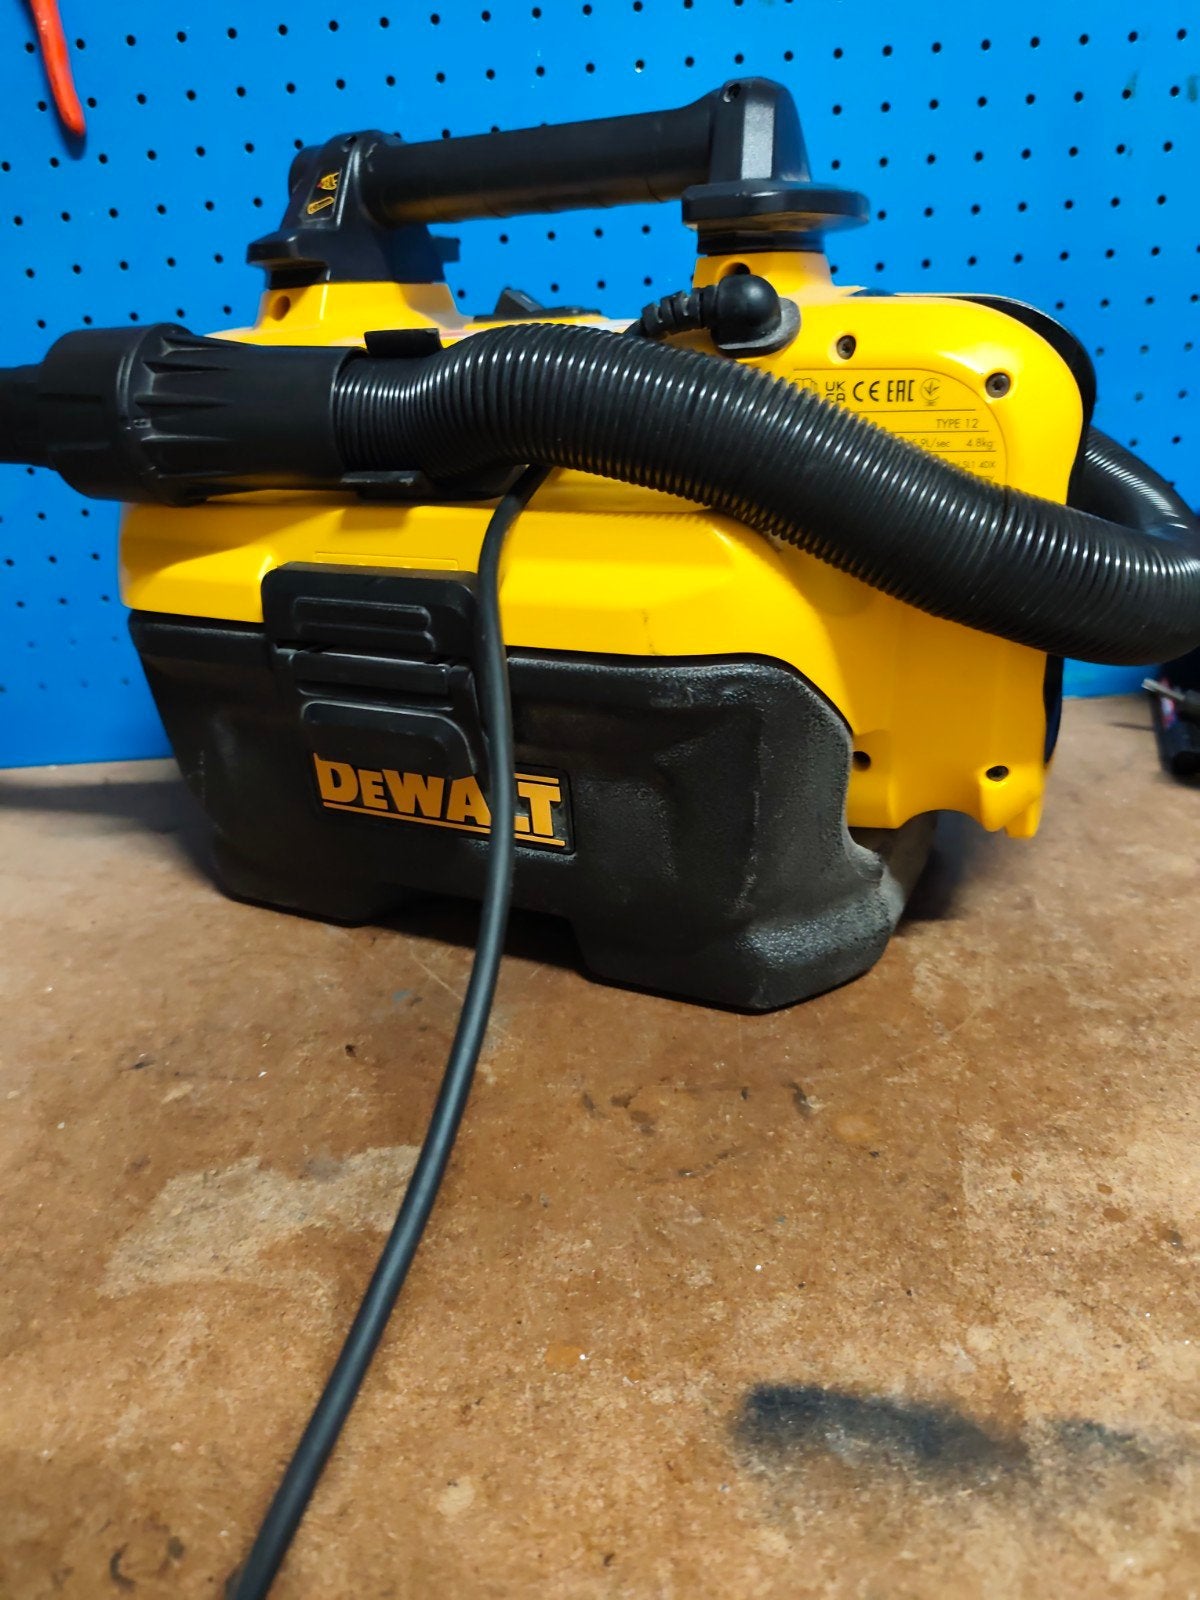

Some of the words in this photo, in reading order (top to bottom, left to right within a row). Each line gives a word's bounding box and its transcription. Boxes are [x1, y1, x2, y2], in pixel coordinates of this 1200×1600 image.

[825, 381, 846, 392] UK
[852, 380, 880, 402] CE
[886, 379, 915, 402] EAC
[936, 418, 961, 429] TYPE
[966, 418, 979, 429] 12
[313, 752, 562, 837] DEWAT
